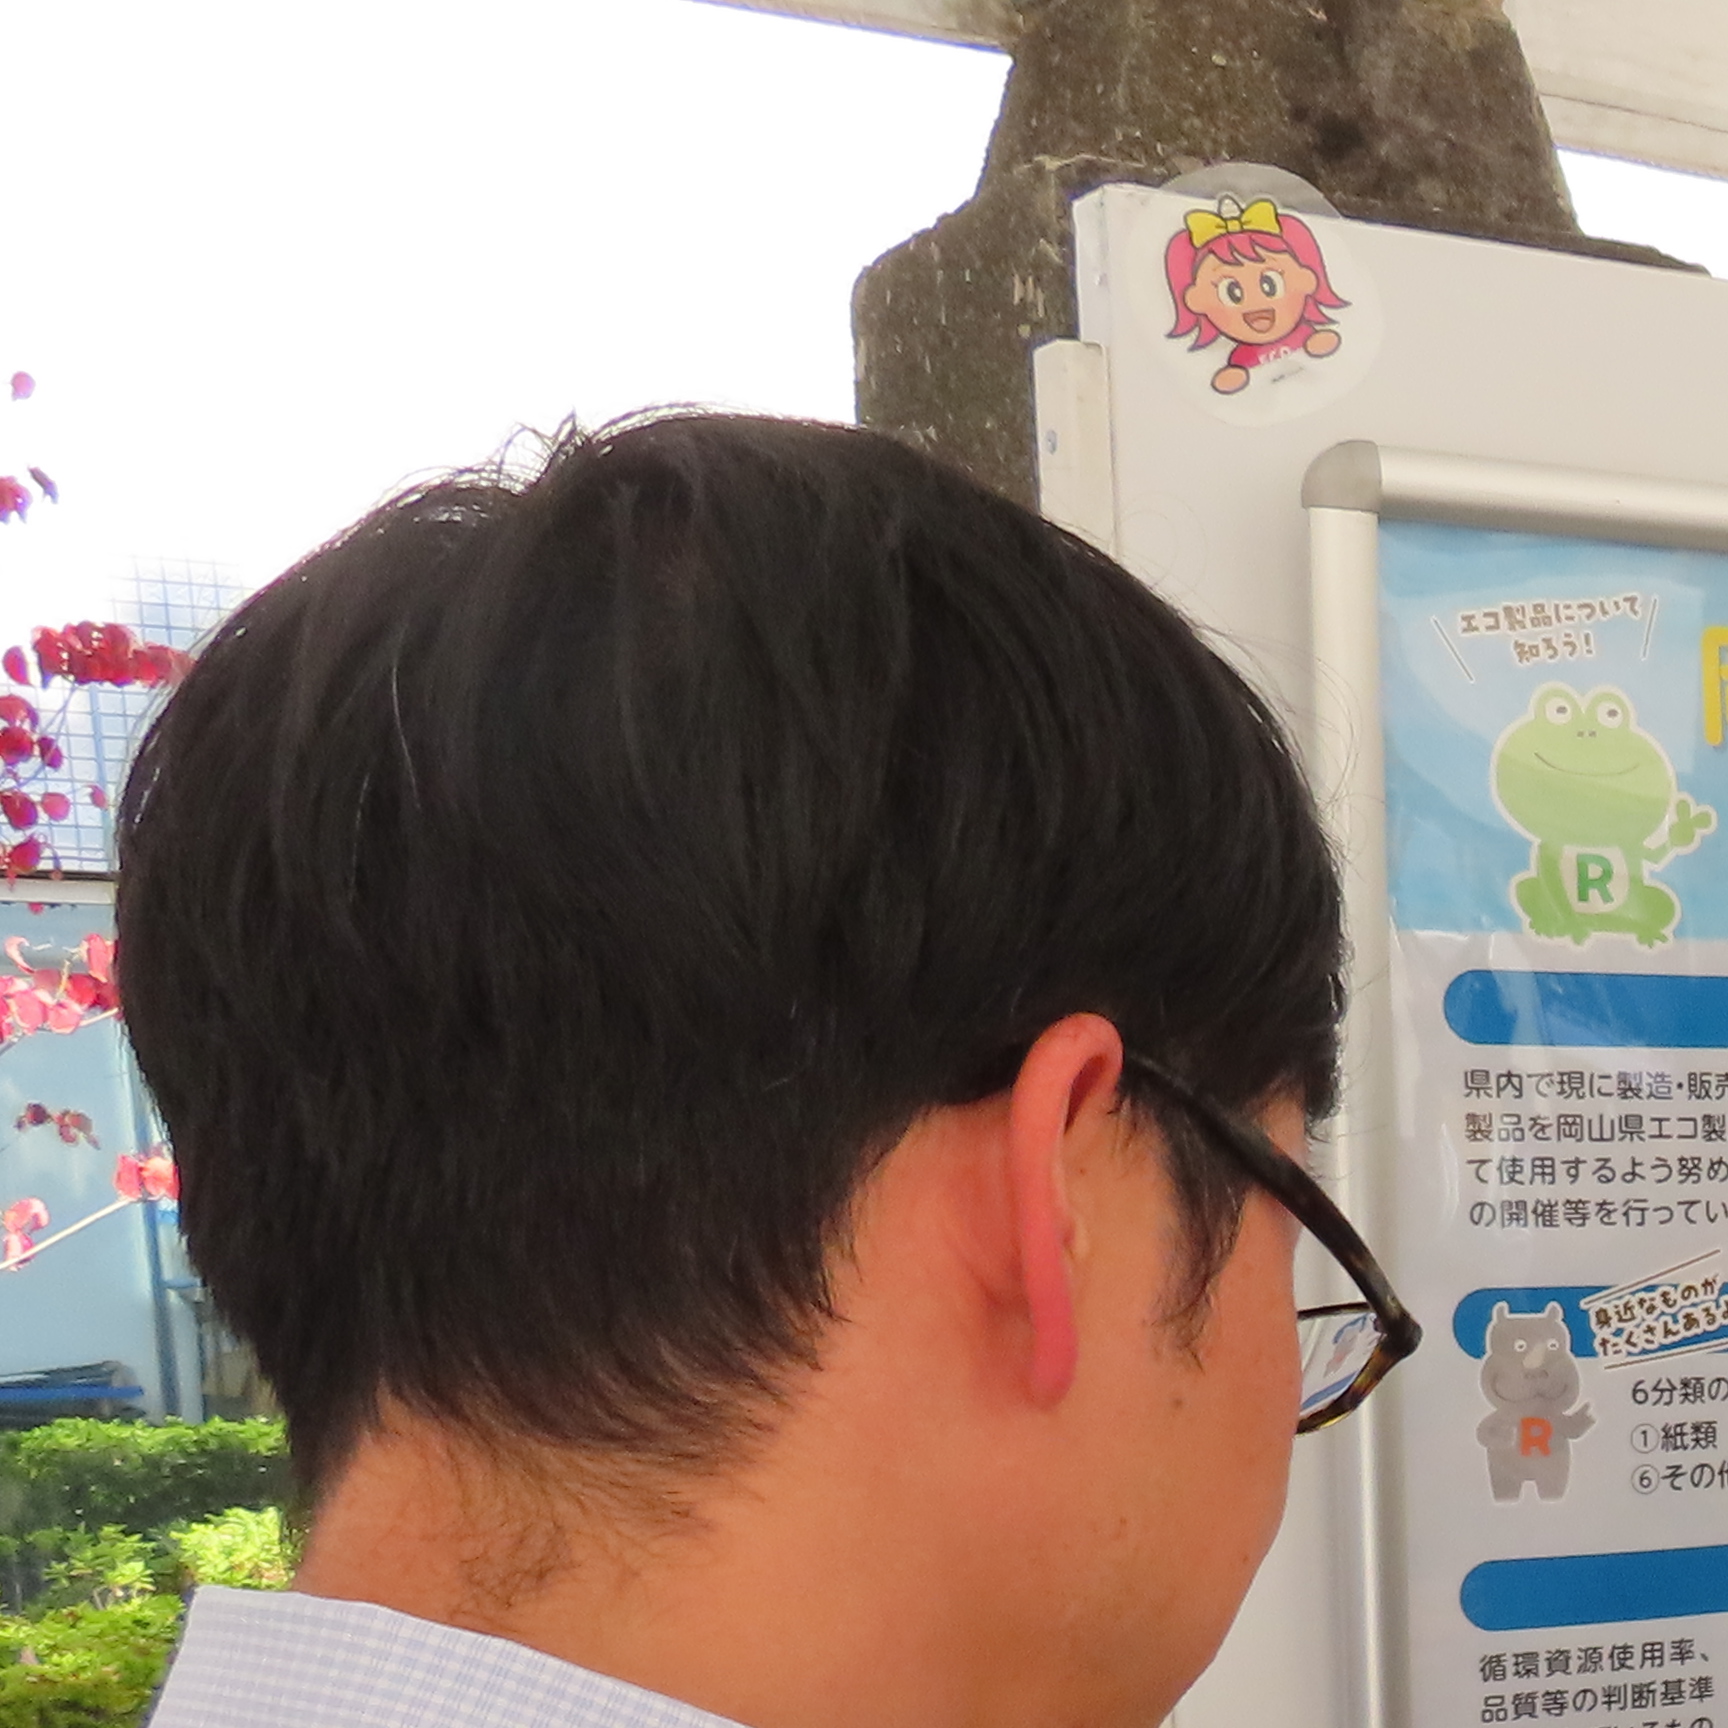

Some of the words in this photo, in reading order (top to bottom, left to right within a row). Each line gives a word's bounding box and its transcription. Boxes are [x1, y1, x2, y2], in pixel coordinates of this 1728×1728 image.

[1460, 594, 1641, 635] エコ製品について
[1576, 853, 1614, 904] R
[1594, 1273, 1720, 1330] 身近なものが
[1519, 1417, 1552, 1458] R
[1630, 1419, 1719, 1454] ①紙類
[1479, 1636, 1711, 1684] 循環資源使用率、
[1480, 1675, 1715, 1724] 品質等の判断基準
